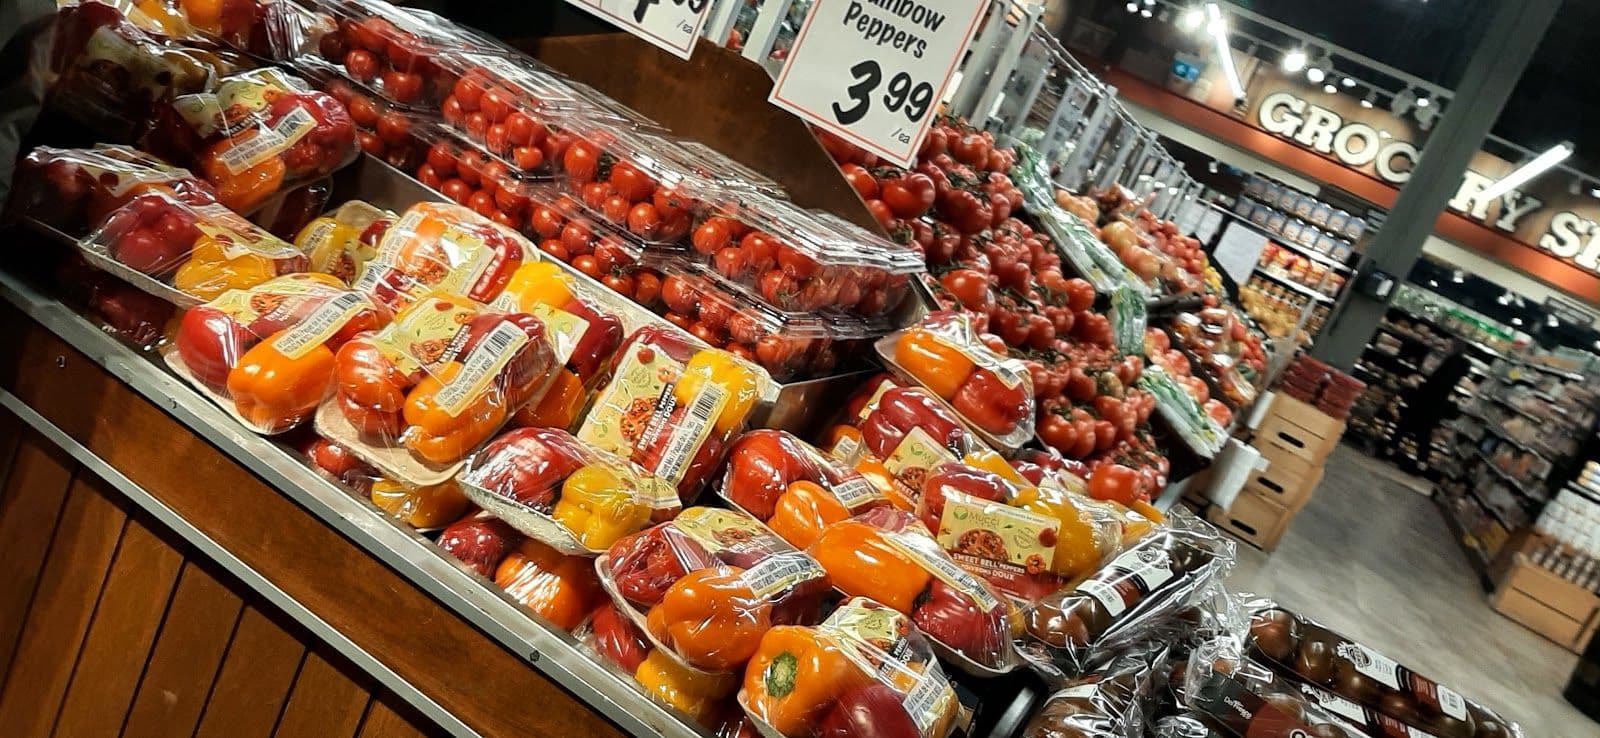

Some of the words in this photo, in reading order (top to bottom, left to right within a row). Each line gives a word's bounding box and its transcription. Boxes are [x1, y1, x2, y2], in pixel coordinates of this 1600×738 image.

[843, 1, 927, 58] Peppers
[1259, 92, 1541, 233] GROCRY
[637, 426, 654, 450] SWEET
[651, 410, 662, 427] BELL
[659, 385, 674, 409] PEPPERS
[663, 396, 677, 418] DOUX
[953, 552, 979, 564] SWEET
[980, 558, 998, 568] BELL
[992, 570, 1015, 580] DOUX
